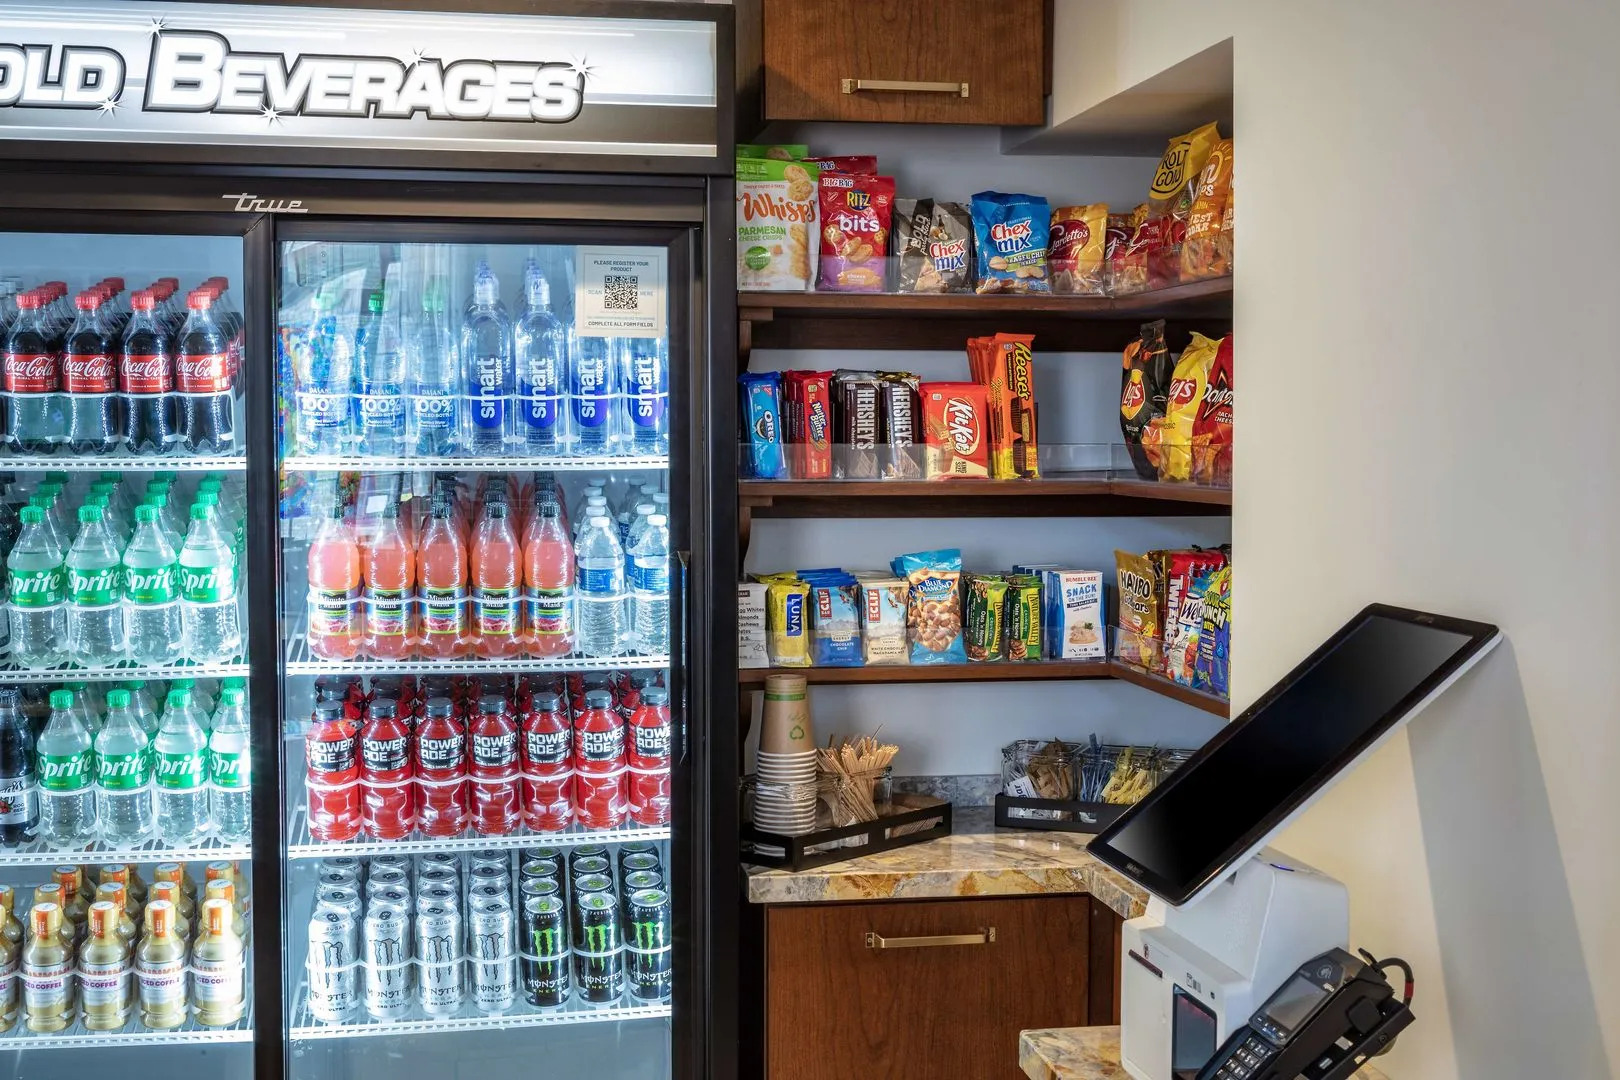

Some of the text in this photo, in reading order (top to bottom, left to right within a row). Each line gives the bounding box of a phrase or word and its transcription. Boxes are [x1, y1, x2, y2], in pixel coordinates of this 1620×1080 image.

[142, 29, 584, 123] BEVERAGES
[743, 192, 816, 223] Whisps
[847, 191, 871, 207] RITZ
[738, 226, 787, 235] PARMESAN
[839, 214, 880, 231] bits
[911, 214, 927, 249] BOLD
[991, 220, 1032, 240] Chex
[930, 239, 966, 258] Chex
[997, 233, 1032, 252] mix
[935, 252, 966, 271] mix
[5, 356, 55, 377] Coca-Cola
[63, 356, 112, 377] Coca-Cola
[122, 357, 169, 377] Coca-Cola
[176, 357, 222, 377] Coca-Co
[1014, 341, 1033, 400] Reese's
[477, 357, 495, 418] smart
[529, 357, 547, 419] smart
[579, 358, 596, 418] smart
[635, 357, 652, 417] smart
[812, 402, 827, 427] Nutter
[857, 389, 875, 450] HERSHEY'S
[892, 387, 913, 448] HERSHEY'S
[764, 410, 774, 444] OREO
[810, 415, 824, 438] Butter
[7, 571, 60, 593] Sprite
[67, 569, 120, 595] Sprite
[124, 568, 177, 593] Sprite
[180, 568, 233, 592] Spri
[918, 580, 953, 592] DIAMOND
[819, 590, 830, 611] CLIF
[1066, 584, 1097, 597] SNACK
[869, 591, 879, 612] CLIF
[1029, 596, 1038, 620] NATURE
[791, 599, 800, 633] LUNA
[363, 736, 406, 751] POWER
[421, 735, 464, 750] POWER
[474, 732, 516, 747] POWER
[528, 729, 570, 744] POWER
[584, 725, 624, 742] POWER
[637, 737, 661, 749] ADE
[363, 750, 387, 761] ADE
[421, 749, 448, 760] ADE
[474, 745, 501, 757] ADE
[528, 742, 554, 755] ADE
[586, 741, 611, 753] ADE
[38, 753, 91, 777] Sprite
[95, 753, 147, 777] Sprite
[155, 753, 205, 777] Sprite
[90, 980, 118, 988] COFFEE
[527, 974, 568, 988] MONSTER
[581, 969, 623, 985] MONSTER
[631, 968, 671, 982] MONSTER
[36, 982, 62, 990] COFFEE
